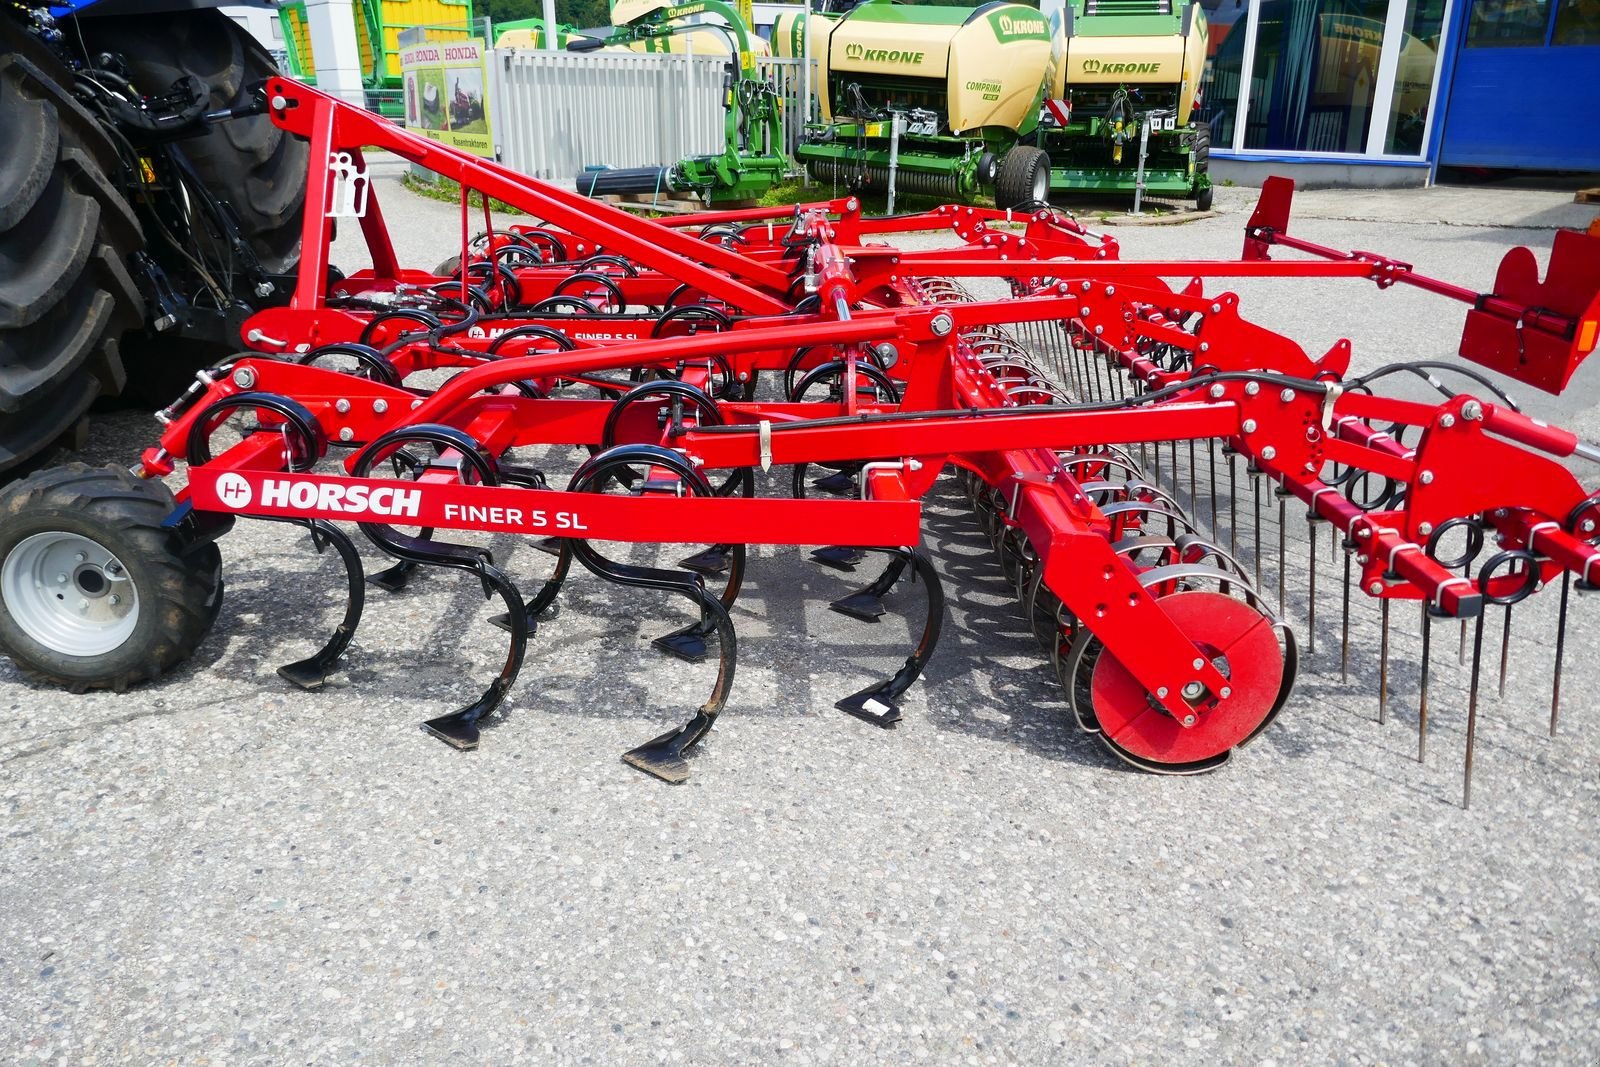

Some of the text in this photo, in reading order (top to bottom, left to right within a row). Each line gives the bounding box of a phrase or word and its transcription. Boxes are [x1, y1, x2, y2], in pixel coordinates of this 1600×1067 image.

[1013, 20, 1044, 35] KRONE
[445, 47, 478, 60] HONDA
[863, 49, 924, 64] KRONE
[1101, 63, 1160, 73] KRONE
[966, 81, 1002, 93] COMPRIMA
[261, 479, 588, 530] HORSCH FINER 5 SL
